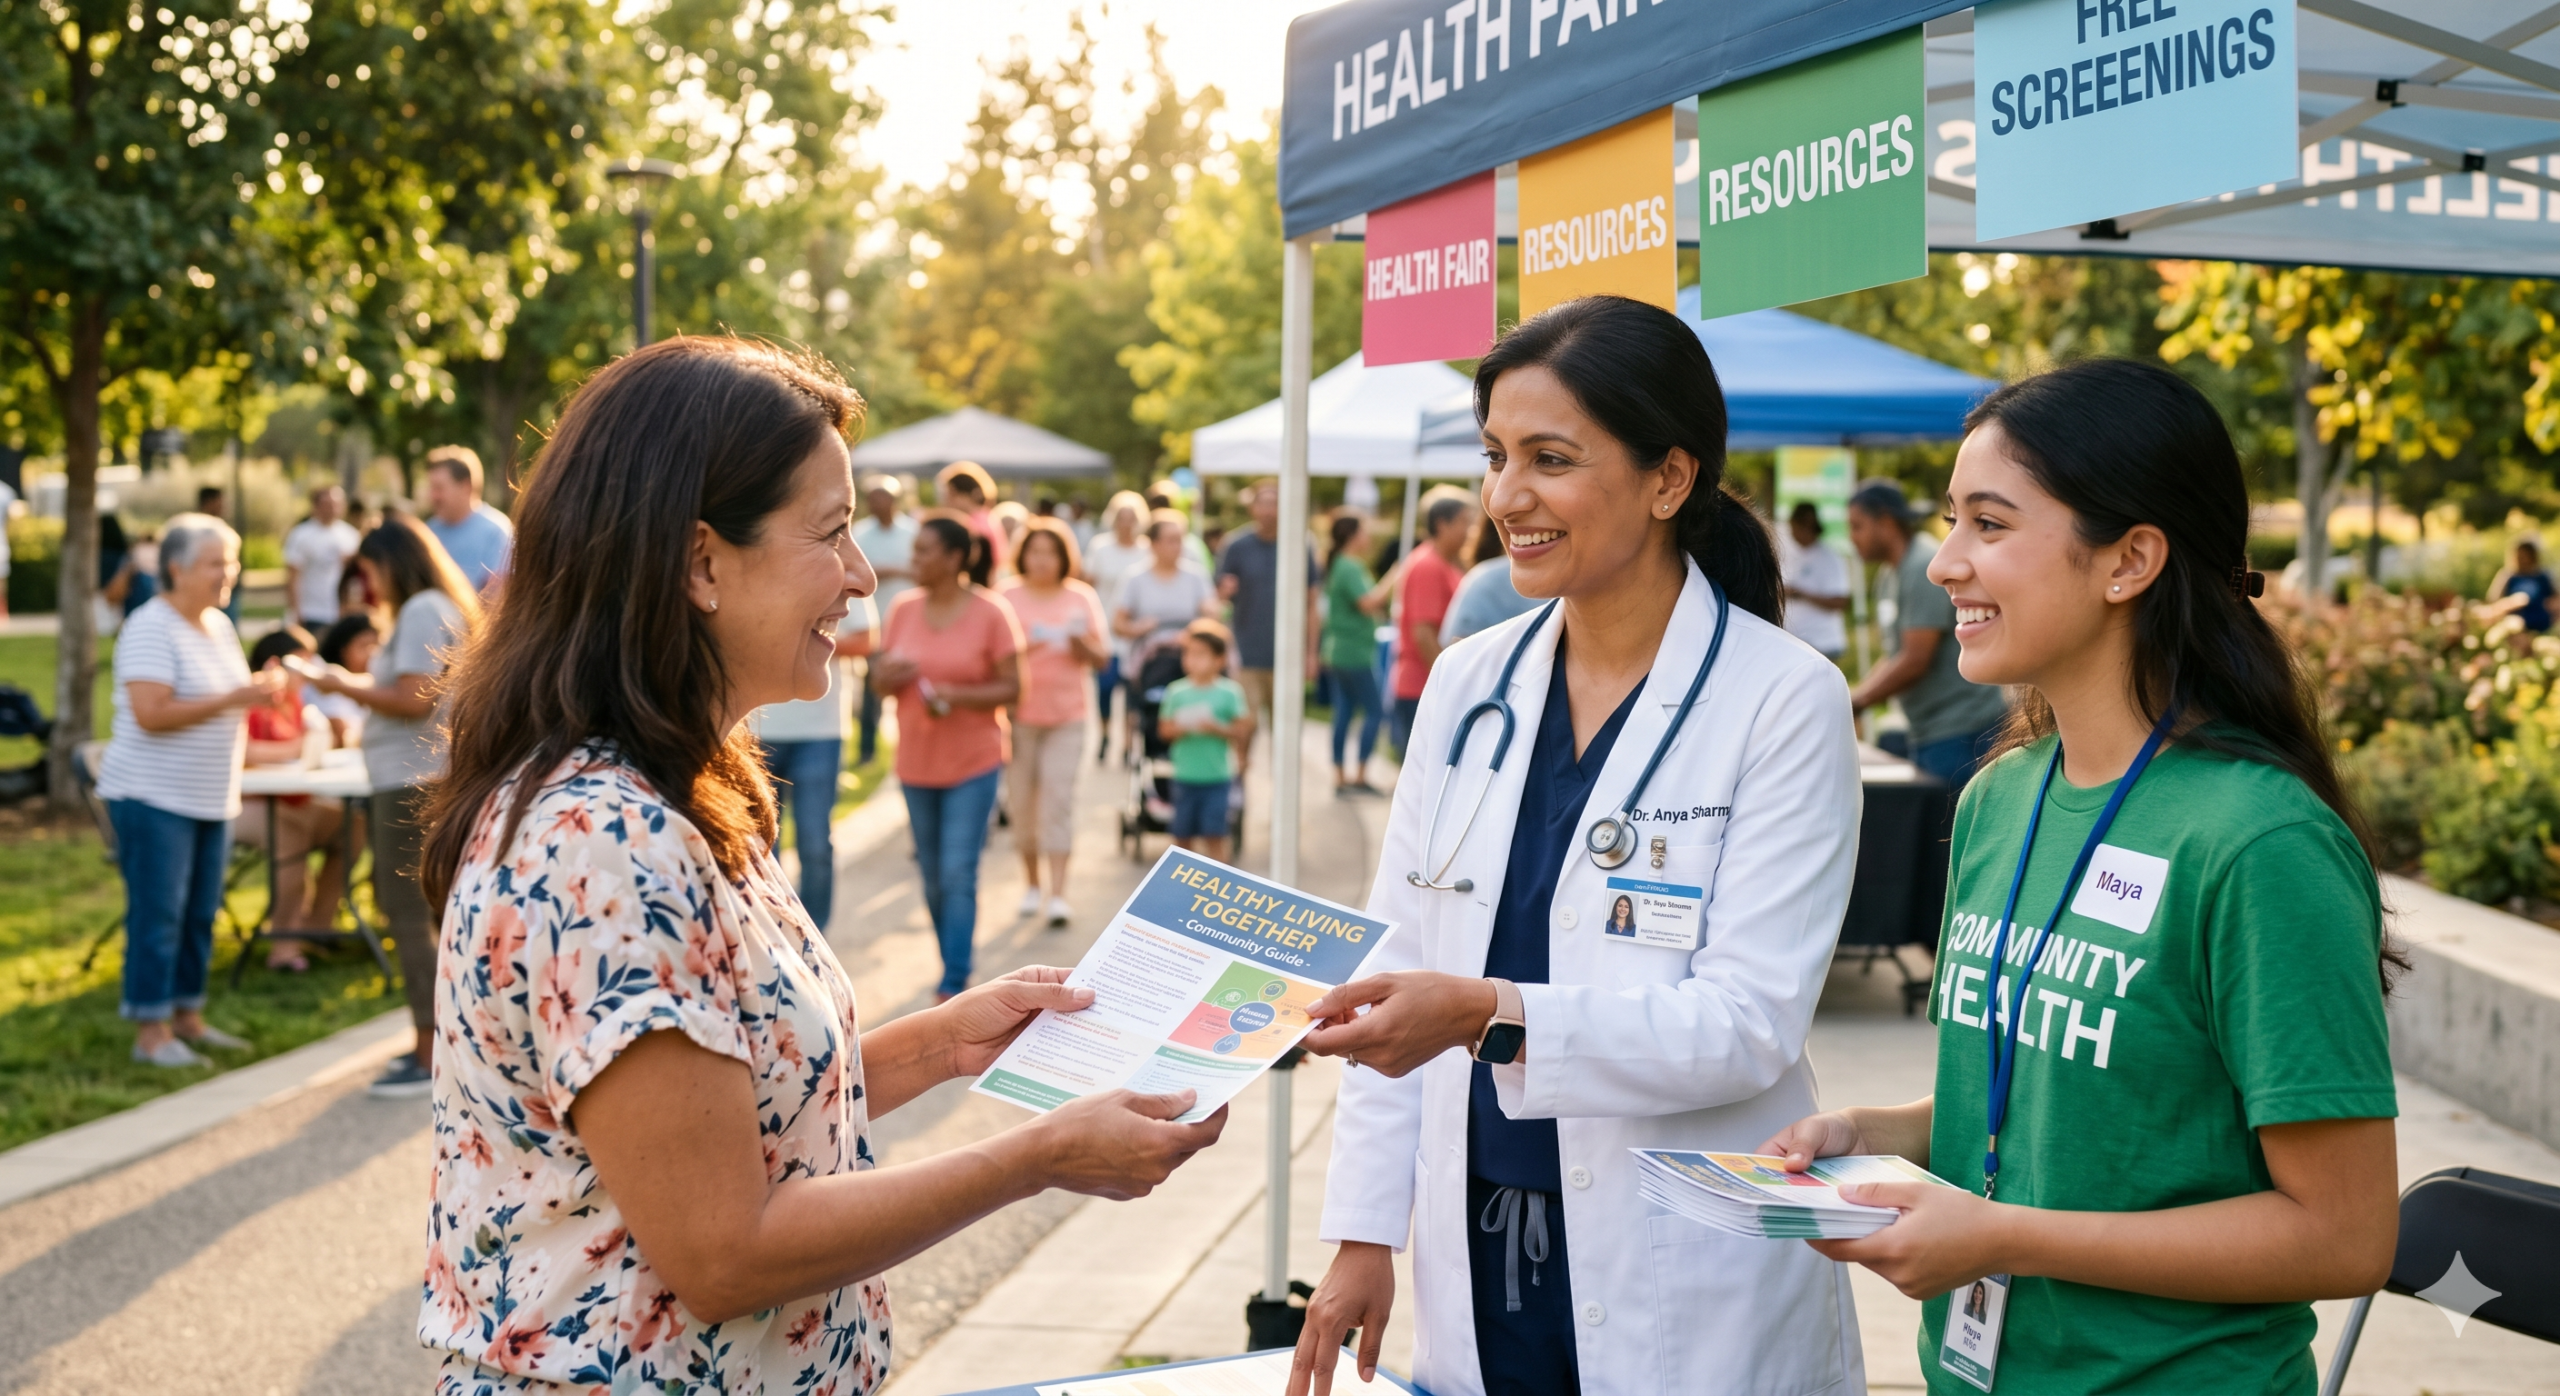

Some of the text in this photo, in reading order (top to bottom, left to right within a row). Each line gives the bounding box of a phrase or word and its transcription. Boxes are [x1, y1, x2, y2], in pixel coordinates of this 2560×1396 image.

[1332, 0, 1511, 142] HEALTH
[1992, 8, 2275, 136] SCREEENINGS
[1709, 114, 1914, 225] RESOURCES
[1368, 238, 1490, 301] HEALTH FAIR
[1524, 195, 1667, 275] RESOURCES
[1632, 808, 1649, 821] Dr.
[1653, 808, 1688, 824] Anya
[1170, 863, 1367, 944] HEALTHY LIVING
[2096, 871, 2143, 900] Maya
[1185, 919, 1264, 955] Community
[1264, 945, 1304, 967] Guide
[1190, 894, 1318, 953] TOGETHER
